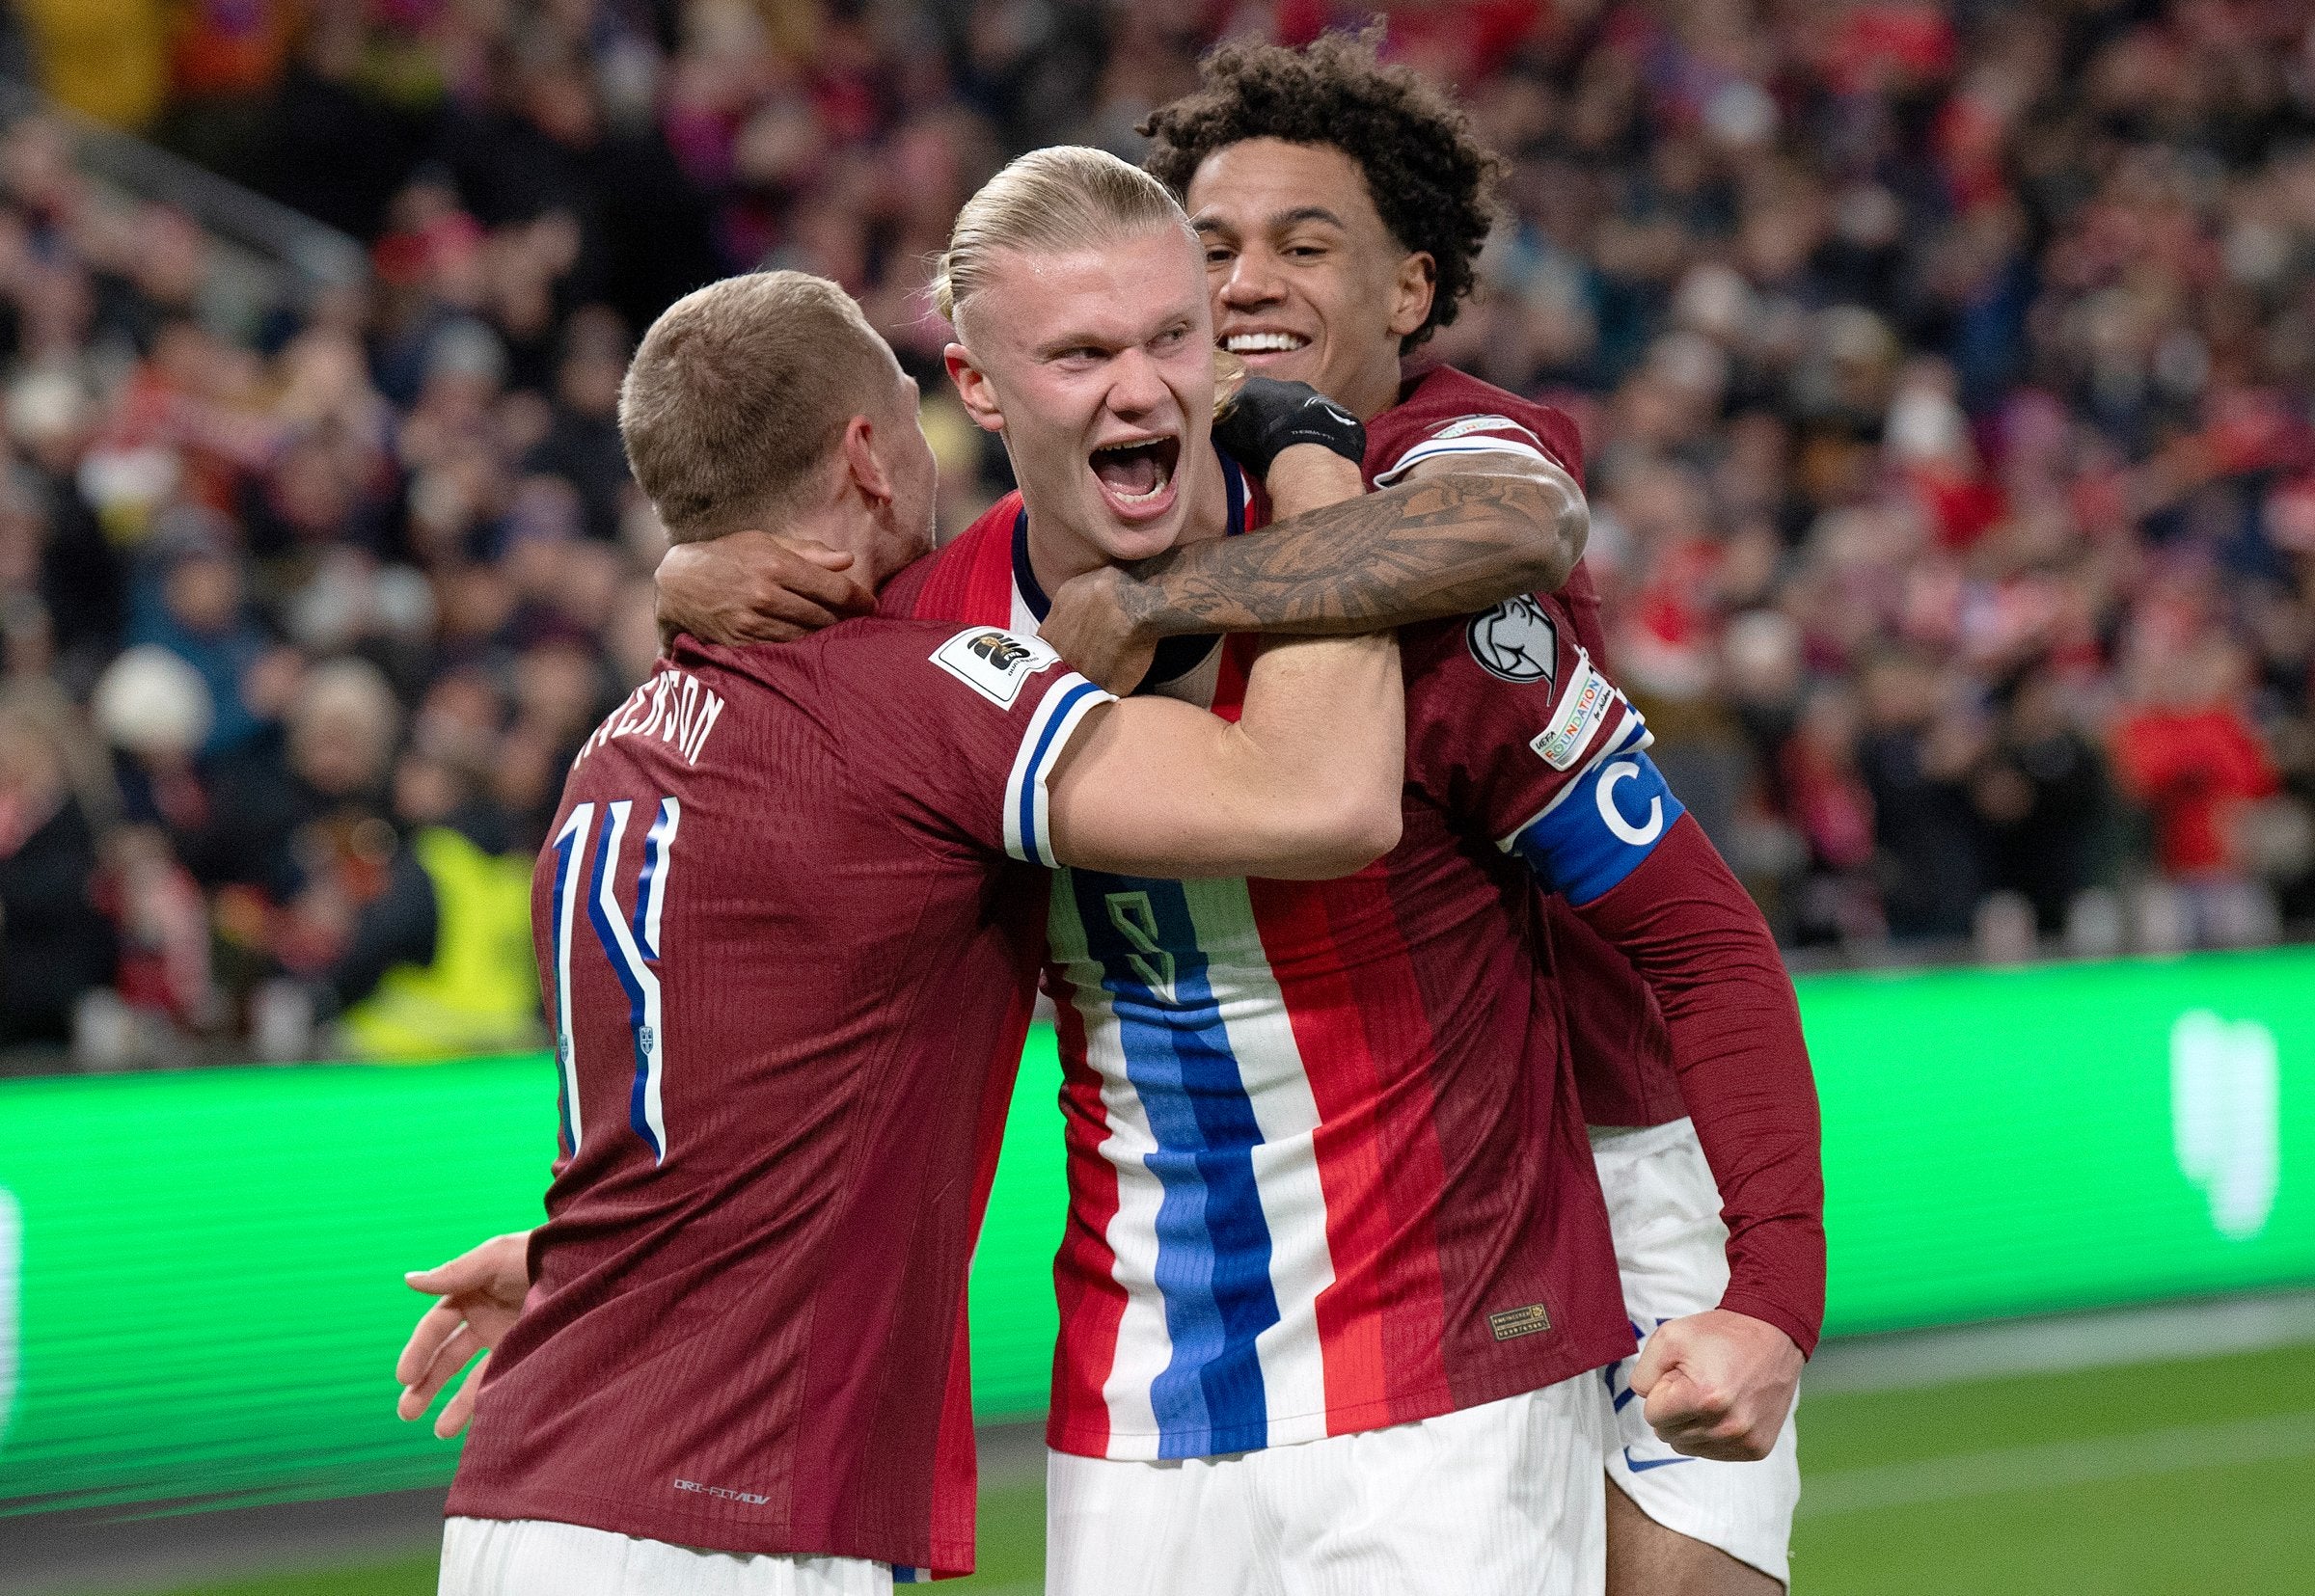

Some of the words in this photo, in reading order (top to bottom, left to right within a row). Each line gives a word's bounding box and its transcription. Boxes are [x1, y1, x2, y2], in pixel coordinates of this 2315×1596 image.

[1536, 731, 1557, 749] UEFA
[1545, 679, 1600, 760] FOUNDATION
[1595, 761, 1664, 847] C
[551, 796, 680, 1168] 14
[1104, 890, 1182, 1006] 9
